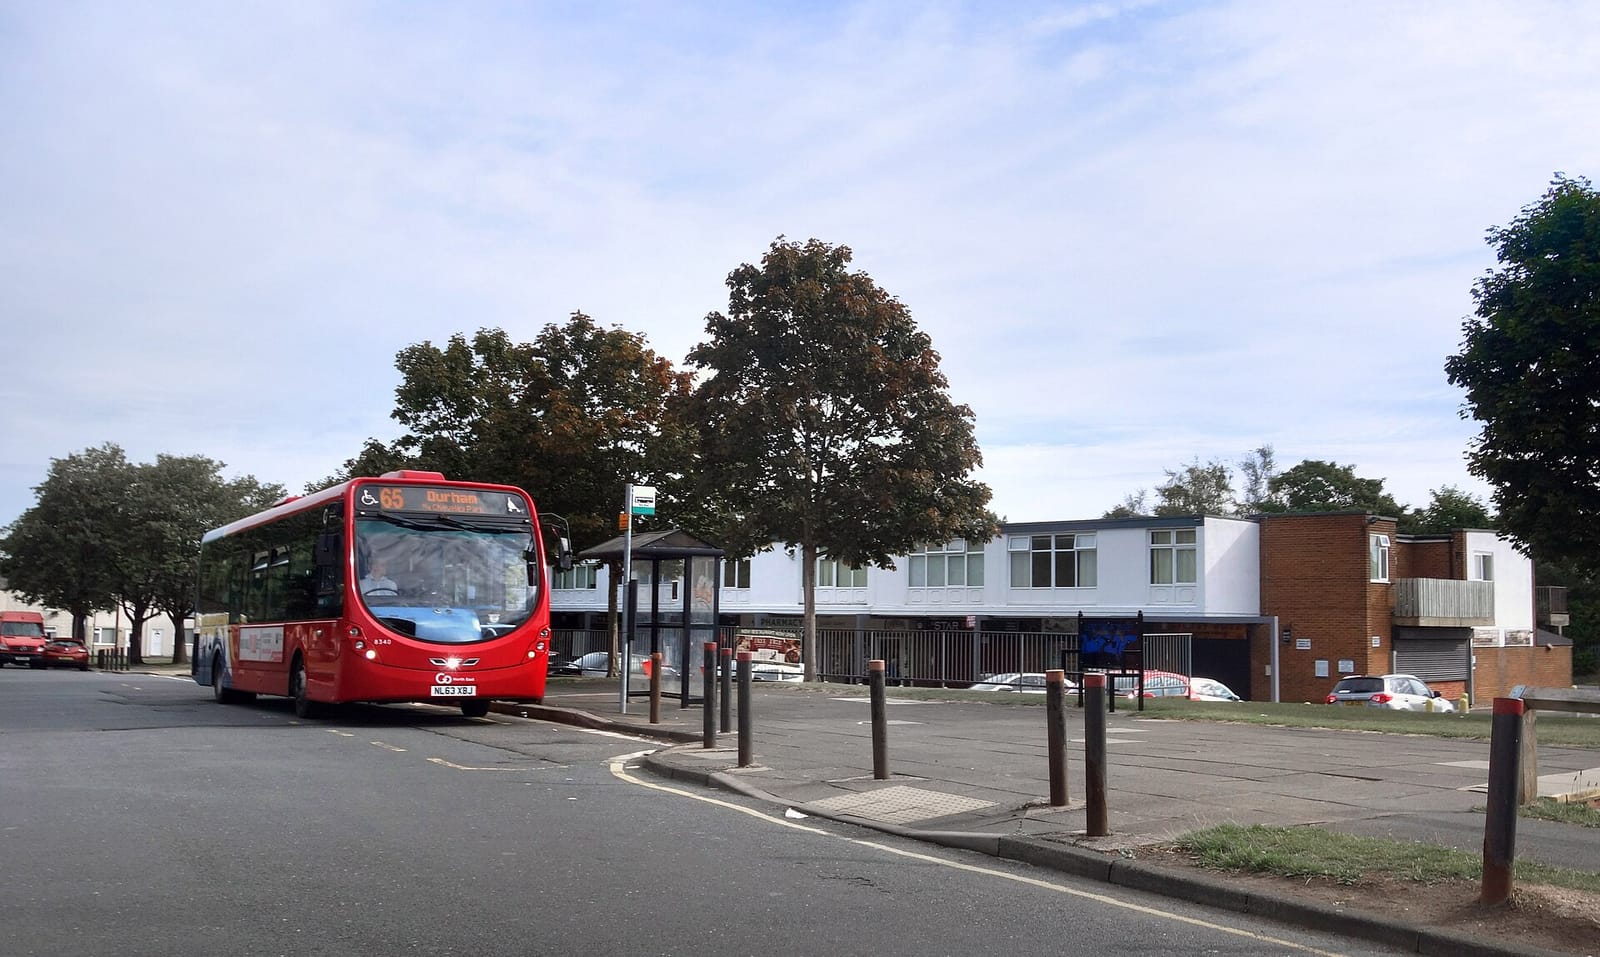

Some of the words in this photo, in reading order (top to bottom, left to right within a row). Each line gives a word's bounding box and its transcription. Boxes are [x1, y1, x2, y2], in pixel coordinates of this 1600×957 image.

[380, 487, 405, 509] 65
[426, 490, 478, 504] Durham
[760, 618, 803, 627] PHARMACY
[435, 672, 452, 684] Go
[434, 687, 455, 695] NL63
[457, 687, 473, 695] XBJ
